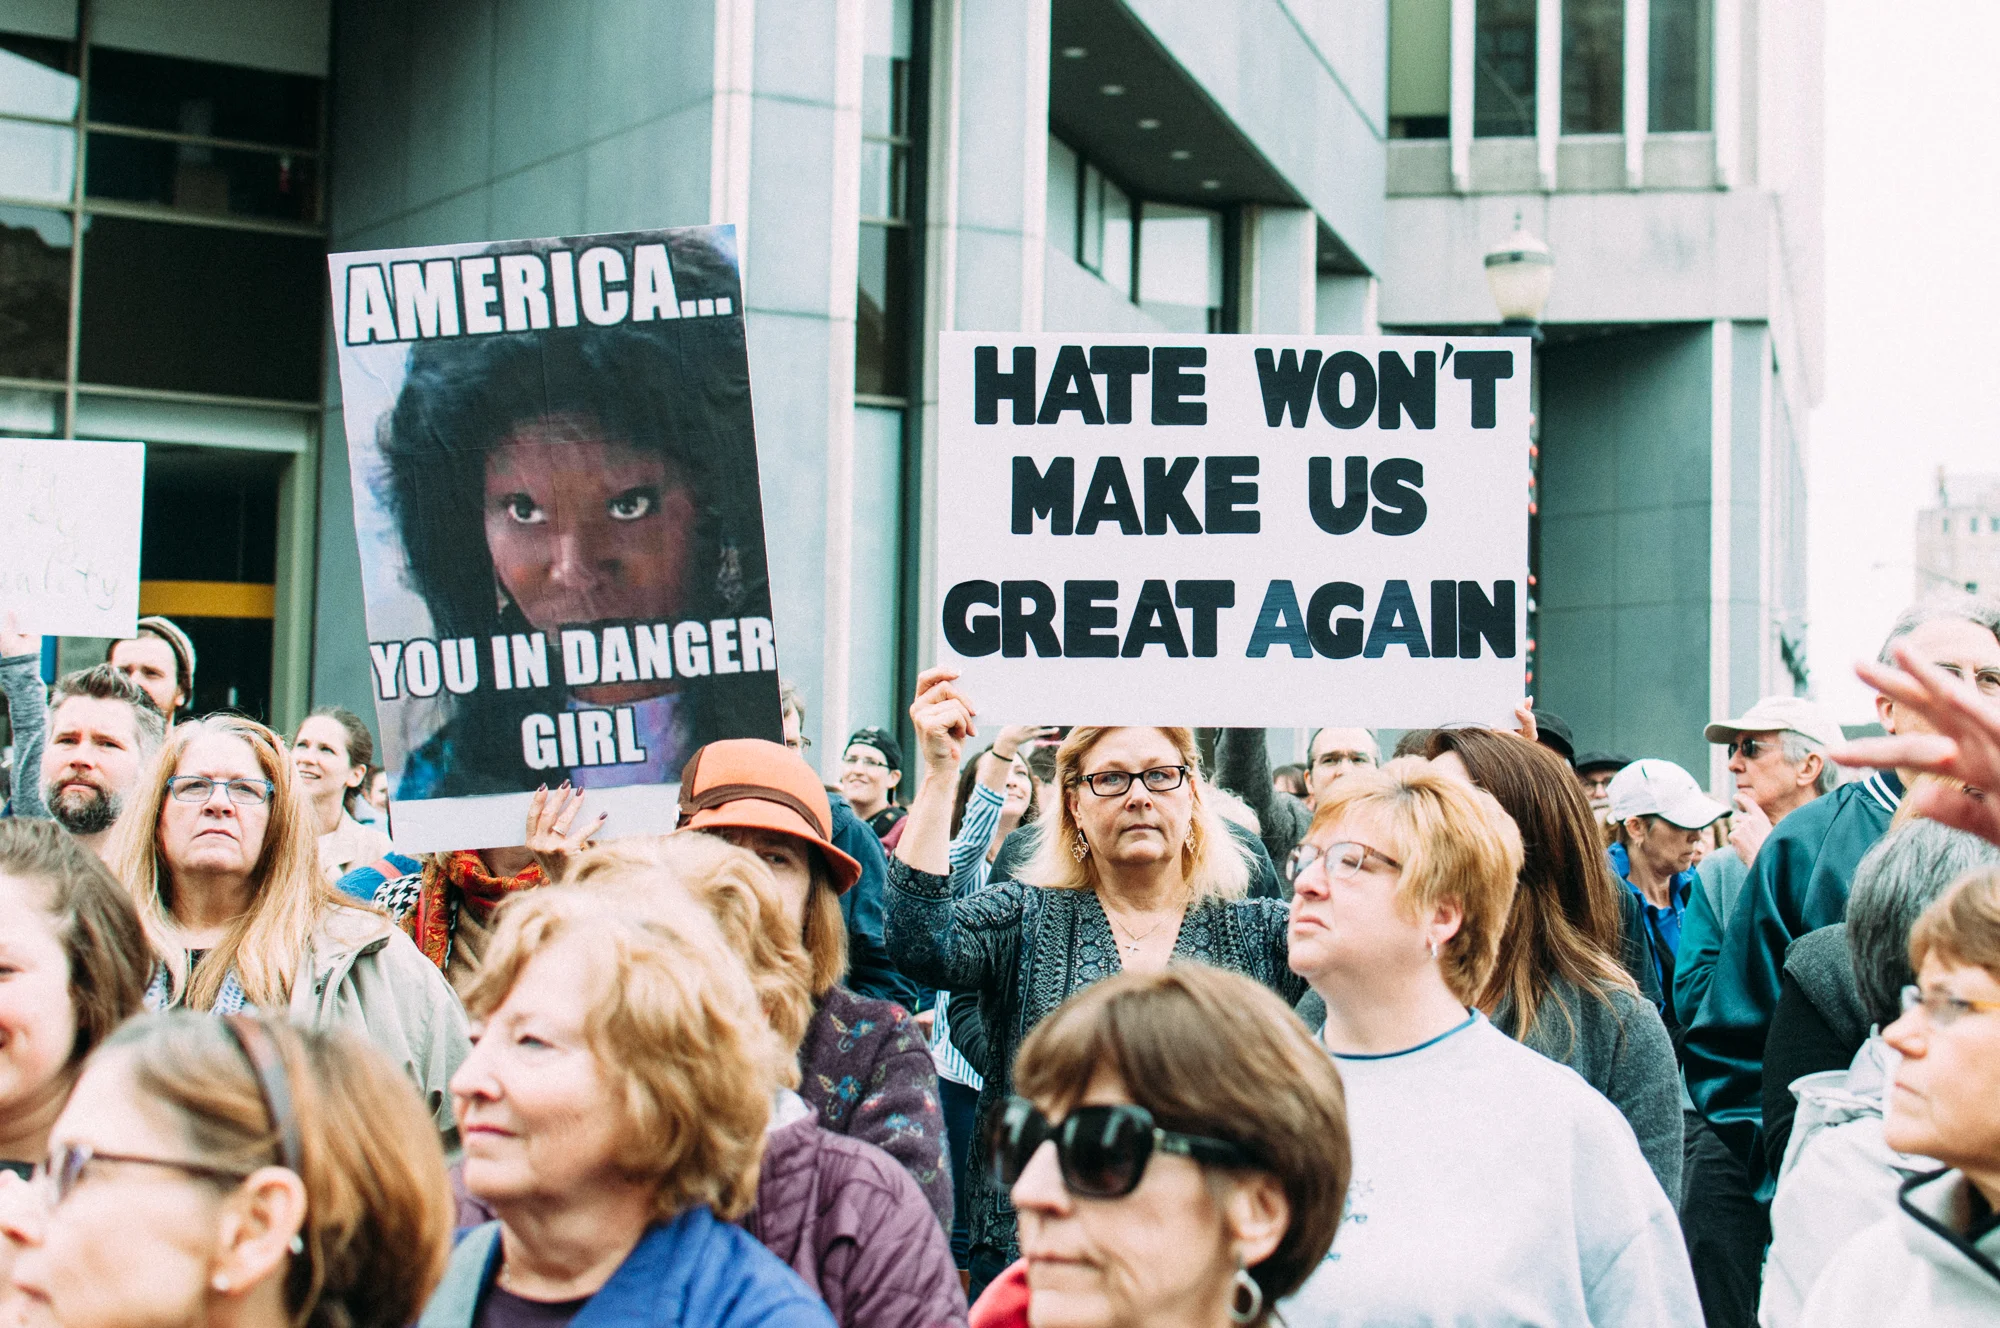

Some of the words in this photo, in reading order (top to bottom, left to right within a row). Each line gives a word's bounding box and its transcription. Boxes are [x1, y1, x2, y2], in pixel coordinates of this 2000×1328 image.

[346, 243, 734, 345] AMERICA...
[974, 345, 1207, 425] HATE
[1254, 342, 1514, 430] WON'T
[1011, 455, 1261, 536] MAKE
[1308, 455, 1428, 537] US
[370, 636, 479, 699] YOU
[491, 632, 550, 690] IN
[561, 617, 777, 684] DANGER
[942, 579, 1236, 659] GREAT
[1246, 579, 1517, 660] AGAIN
[521, 706, 647, 770] GIRL
